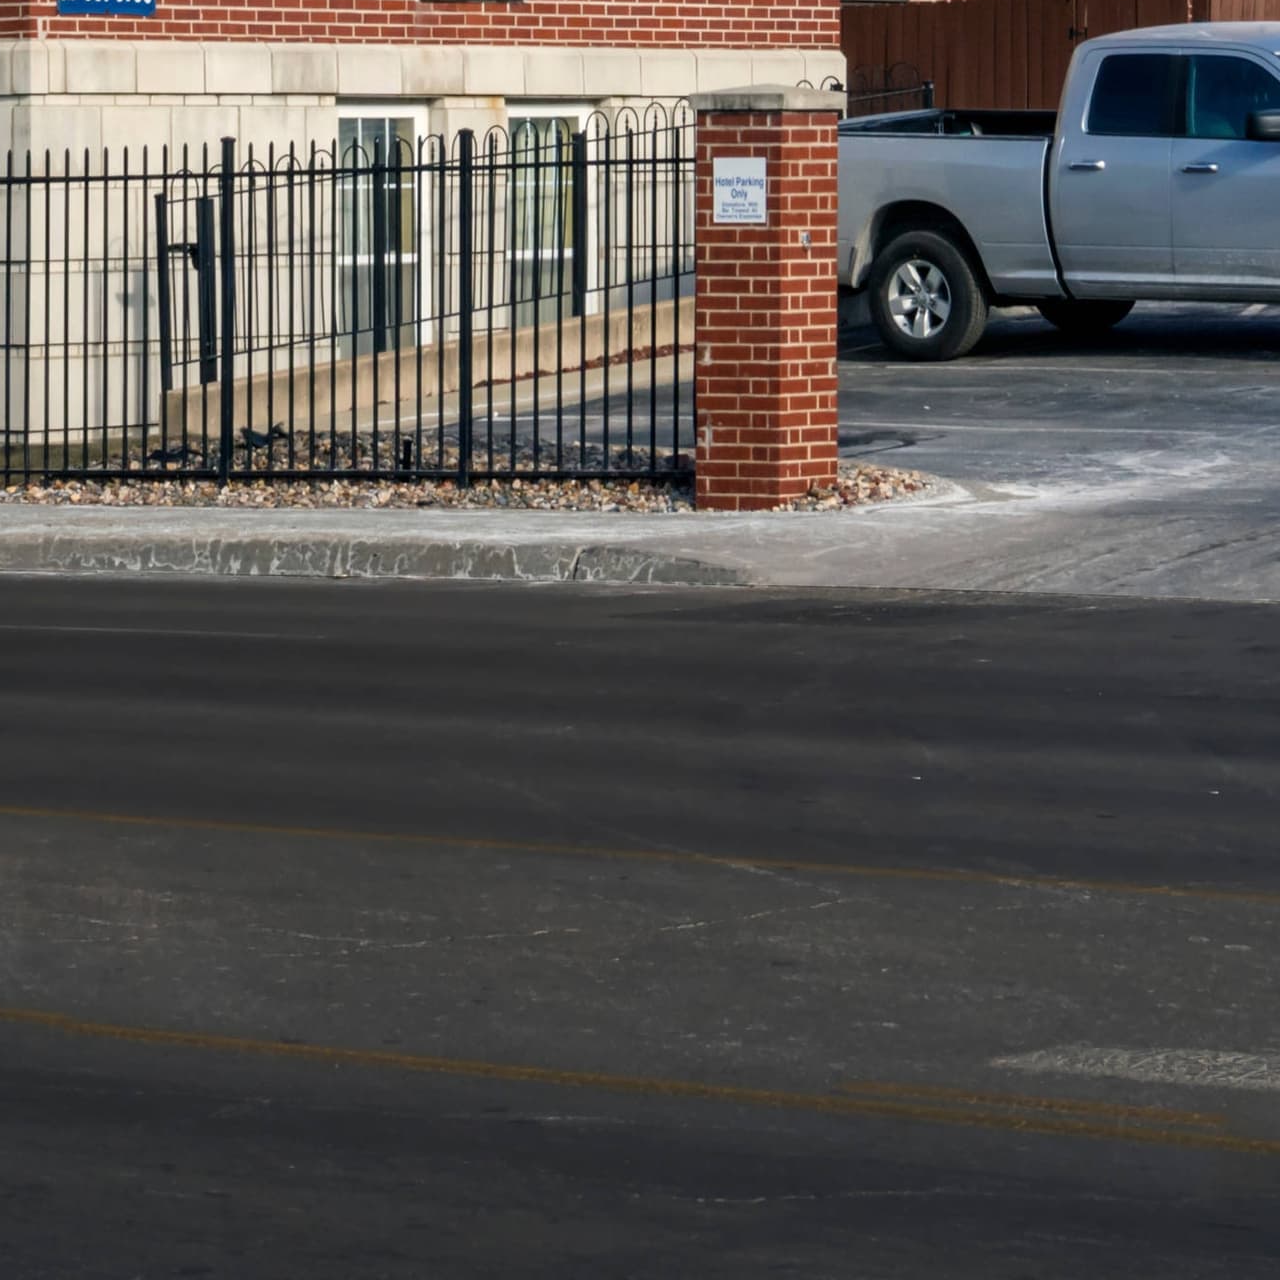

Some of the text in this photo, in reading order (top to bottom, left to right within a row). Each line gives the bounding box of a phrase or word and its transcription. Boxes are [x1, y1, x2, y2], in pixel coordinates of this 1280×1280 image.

[715, 176, 764, 189] Hotel Parking
[730, 187, 748, 200] Only
